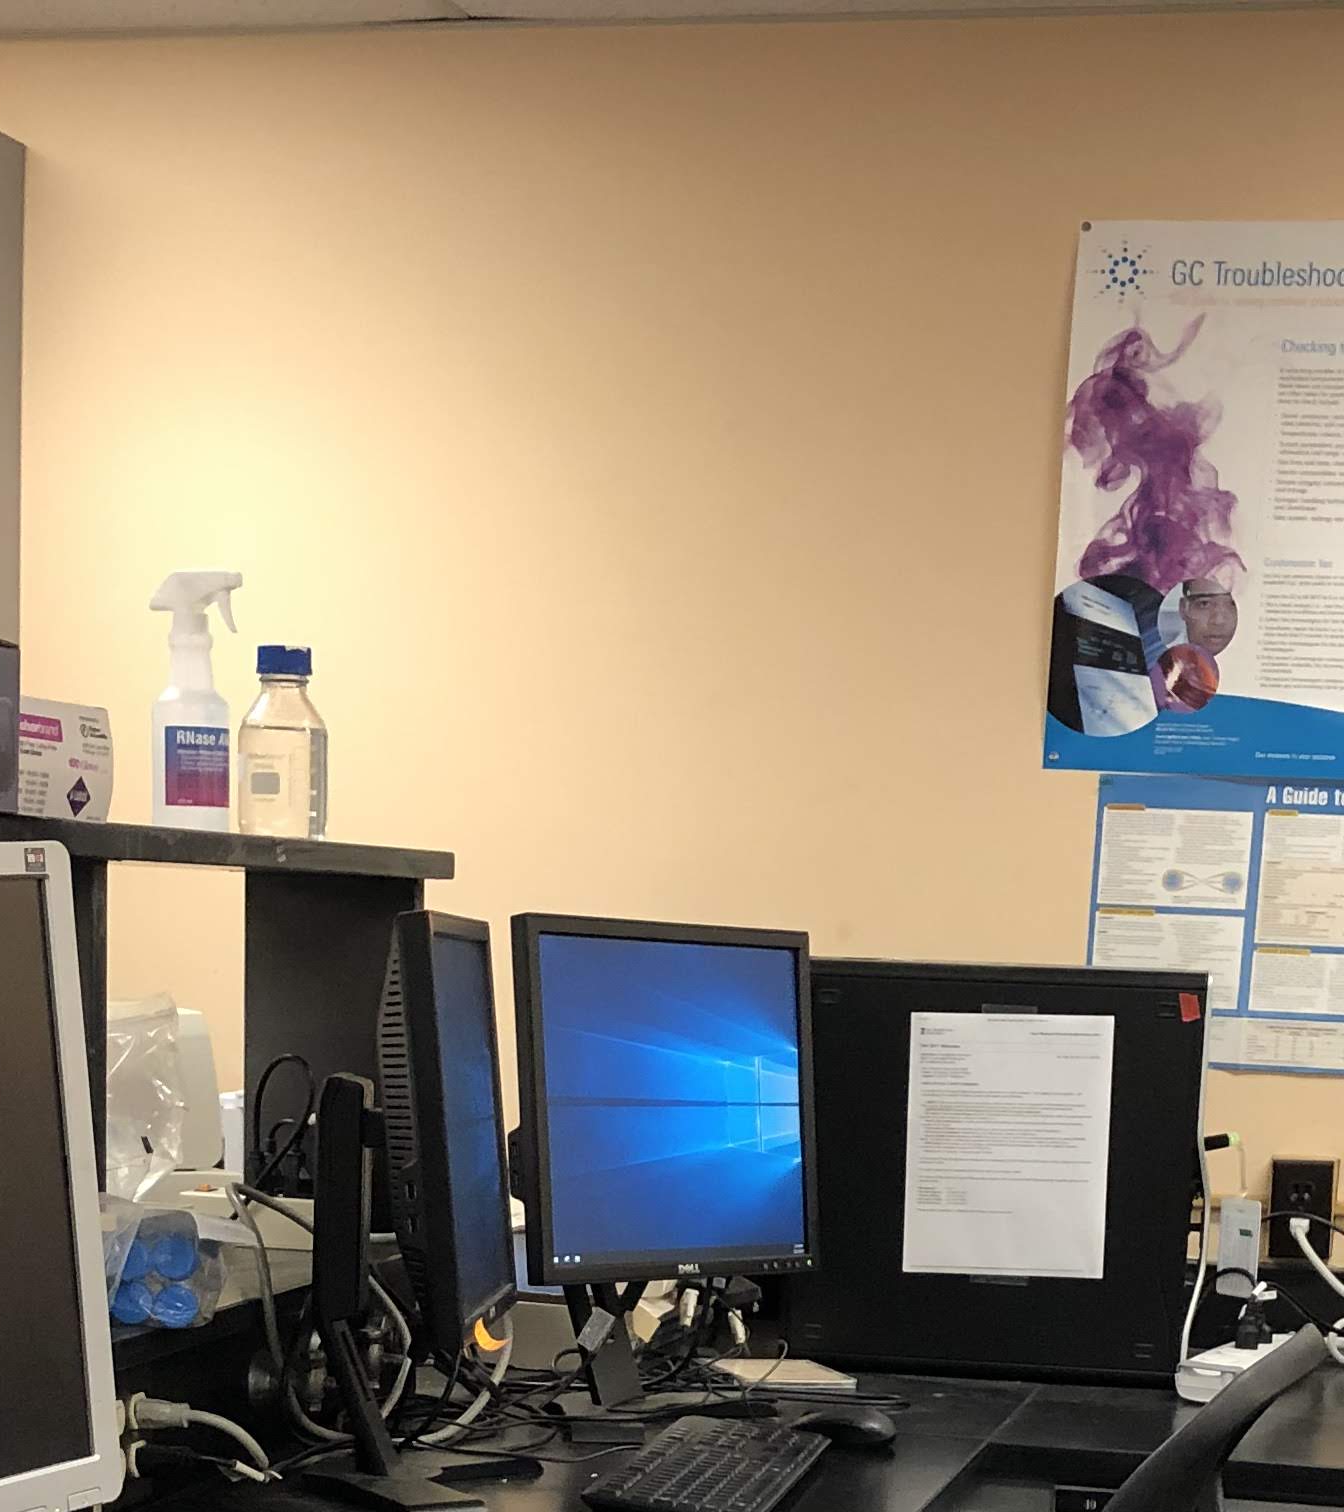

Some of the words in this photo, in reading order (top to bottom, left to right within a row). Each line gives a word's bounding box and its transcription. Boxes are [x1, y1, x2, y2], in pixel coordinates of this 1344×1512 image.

[1171, 259, 1205, 286] GC
[1281, 339, 1337, 356] Checking
[176, 730, 216, 746] RNase
[1266, 786, 1277, 804] A
[1282, 787, 1328, 806] Guide
[678, 1263, 701, 1274] DELL
